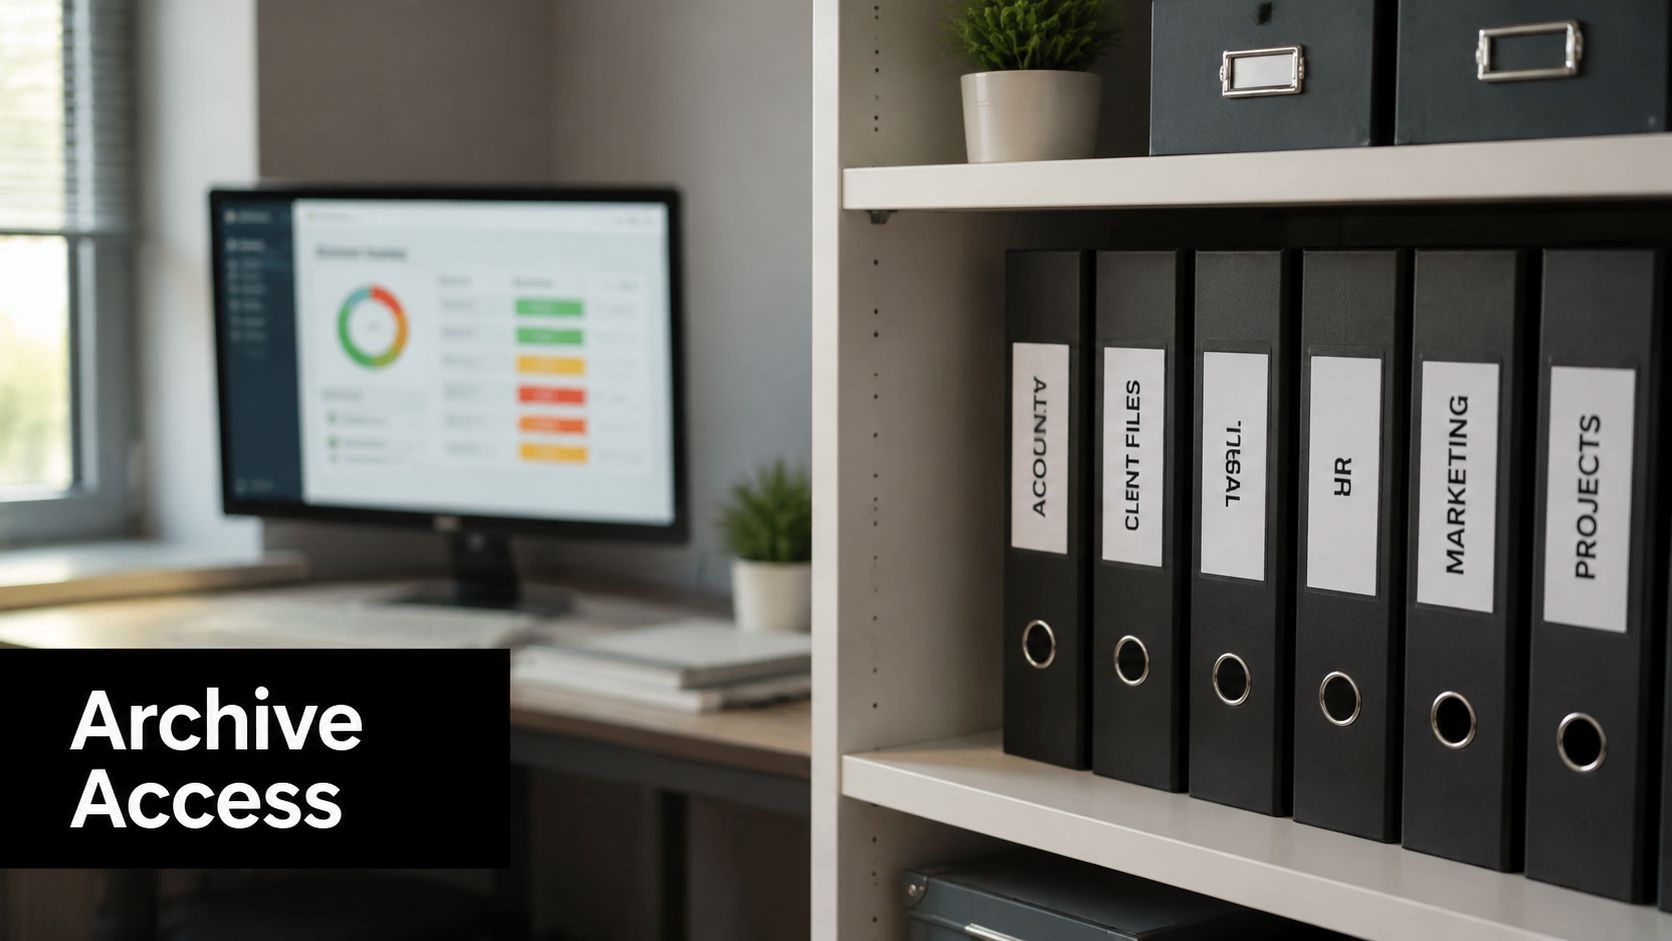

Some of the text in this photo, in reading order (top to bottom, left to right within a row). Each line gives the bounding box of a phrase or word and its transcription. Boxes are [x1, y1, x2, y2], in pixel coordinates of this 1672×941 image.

[1125, 380, 1140, 530] CLENT FILES
[1446, 396, 1468, 575] MARKETING
[1575, 415, 1601, 580] PROJECTS
